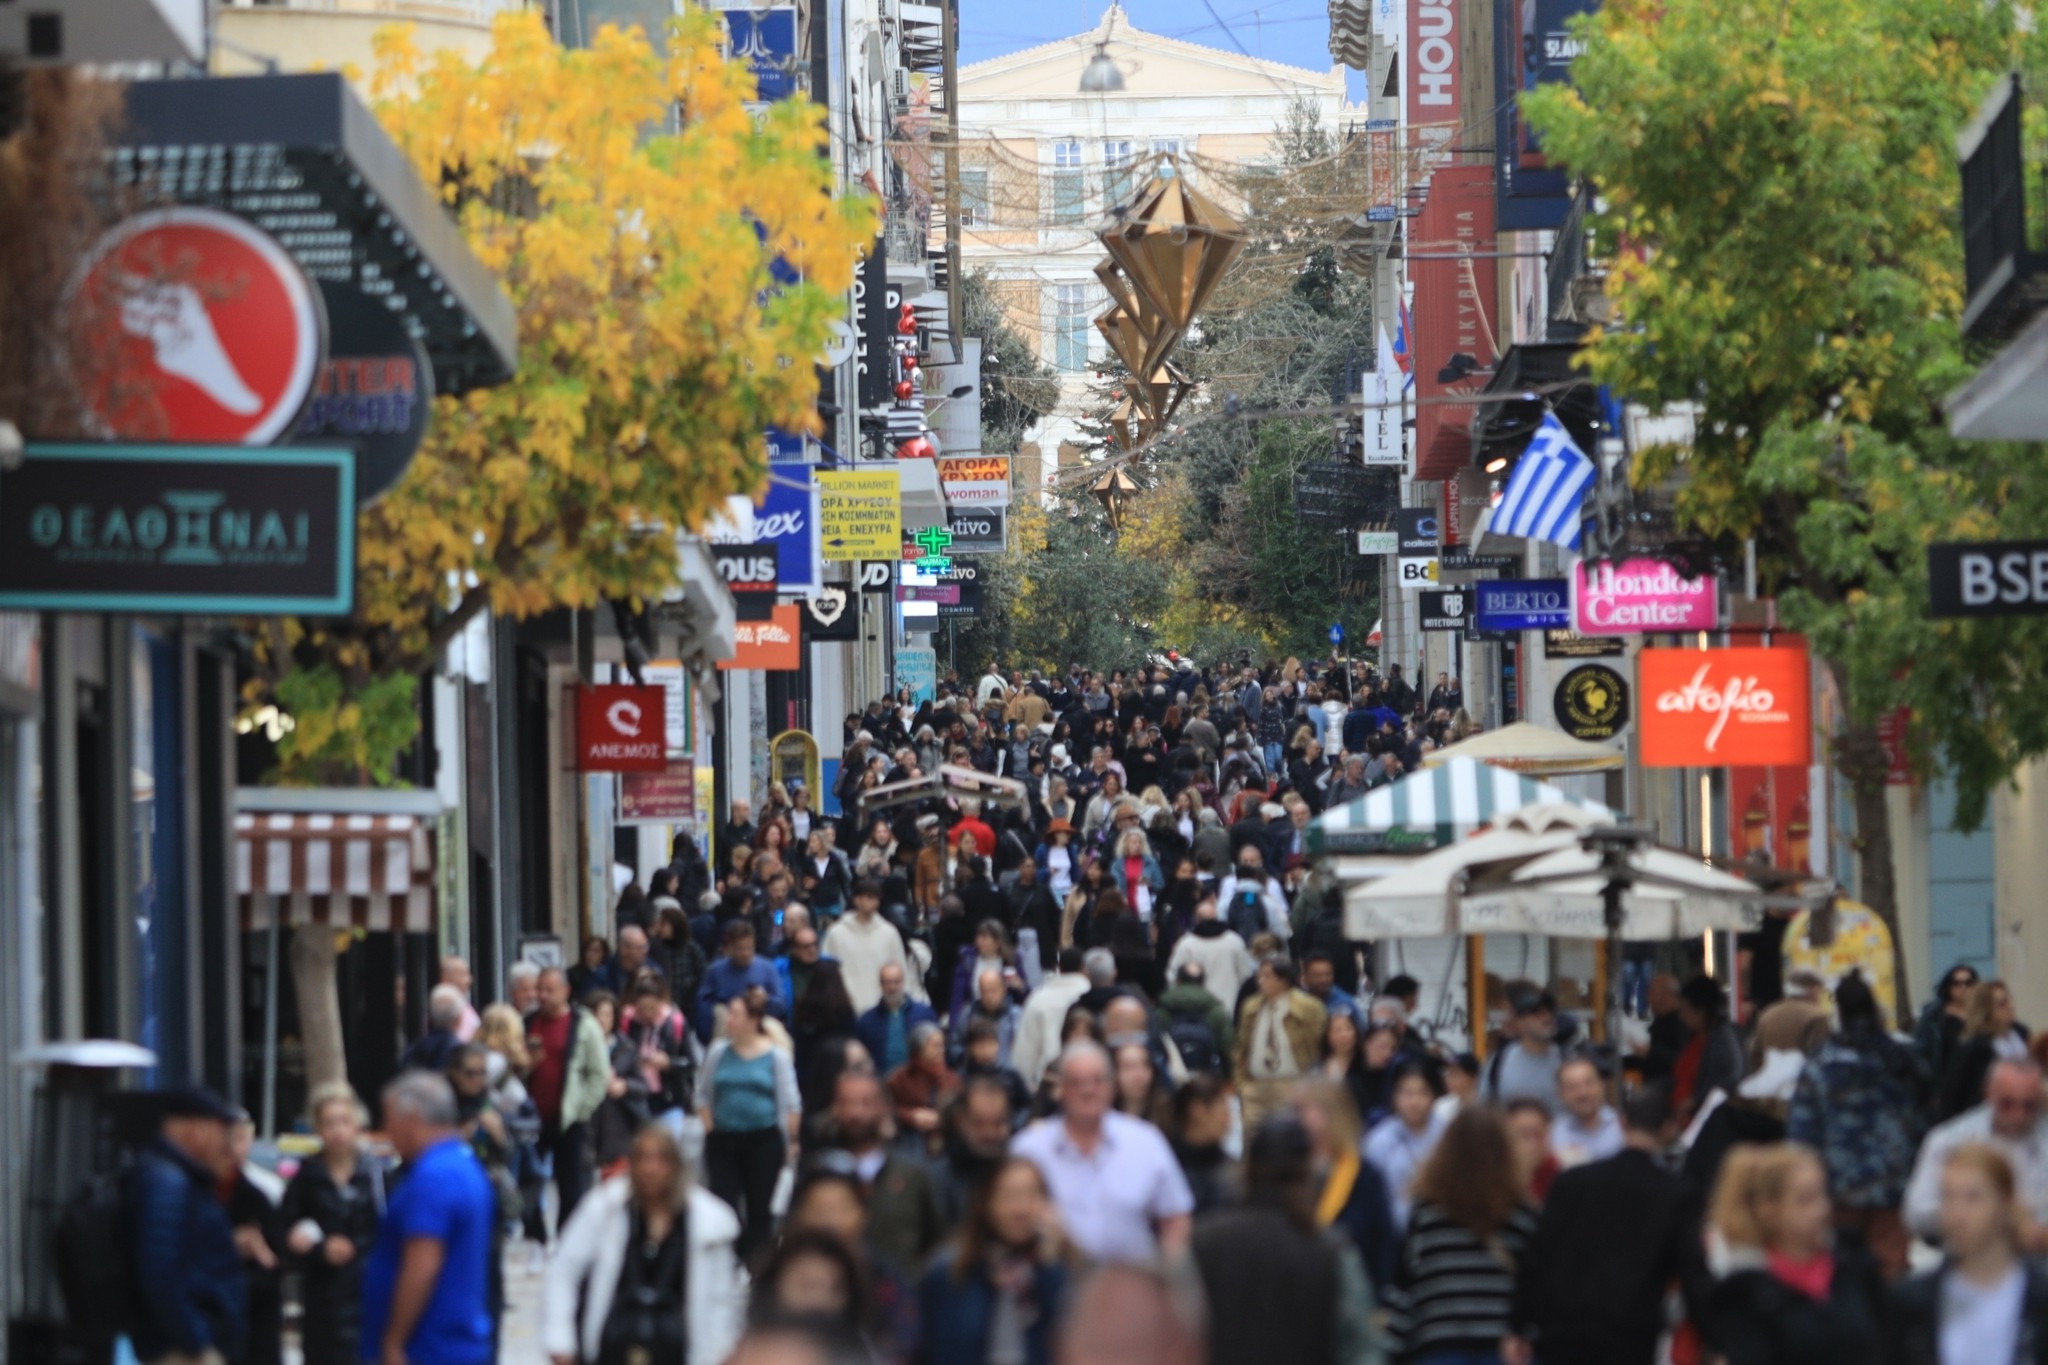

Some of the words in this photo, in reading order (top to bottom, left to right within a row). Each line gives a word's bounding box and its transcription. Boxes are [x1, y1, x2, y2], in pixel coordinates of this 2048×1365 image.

[1417, 0, 1454, 105] HOU
[943, 458, 1000, 471] ΑΓΟΡΑ
[858, 480, 895, 490] MARKET
[947, 488, 999, 499] woman
[848, 497, 892, 508] ΧΡΥΣΟΥ
[838, 510, 896, 520] ΚΟΣΜΗΜΑΤΩΝ
[849, 524, 892, 535] ΕΝΕΧΥΡΑ
[918, 559, 950, 567] PHARMACY
[1588, 566, 1704, 596] Hondos
[1486, 592, 1560, 609] BERTO
[1586, 599, 1693, 626] Center
[1423, 617, 1465, 627] ANTETOKOU
[1576, 727, 1613, 737] COFFEE
[589, 744, 661, 759] ΑΝΕΜΟΣ
